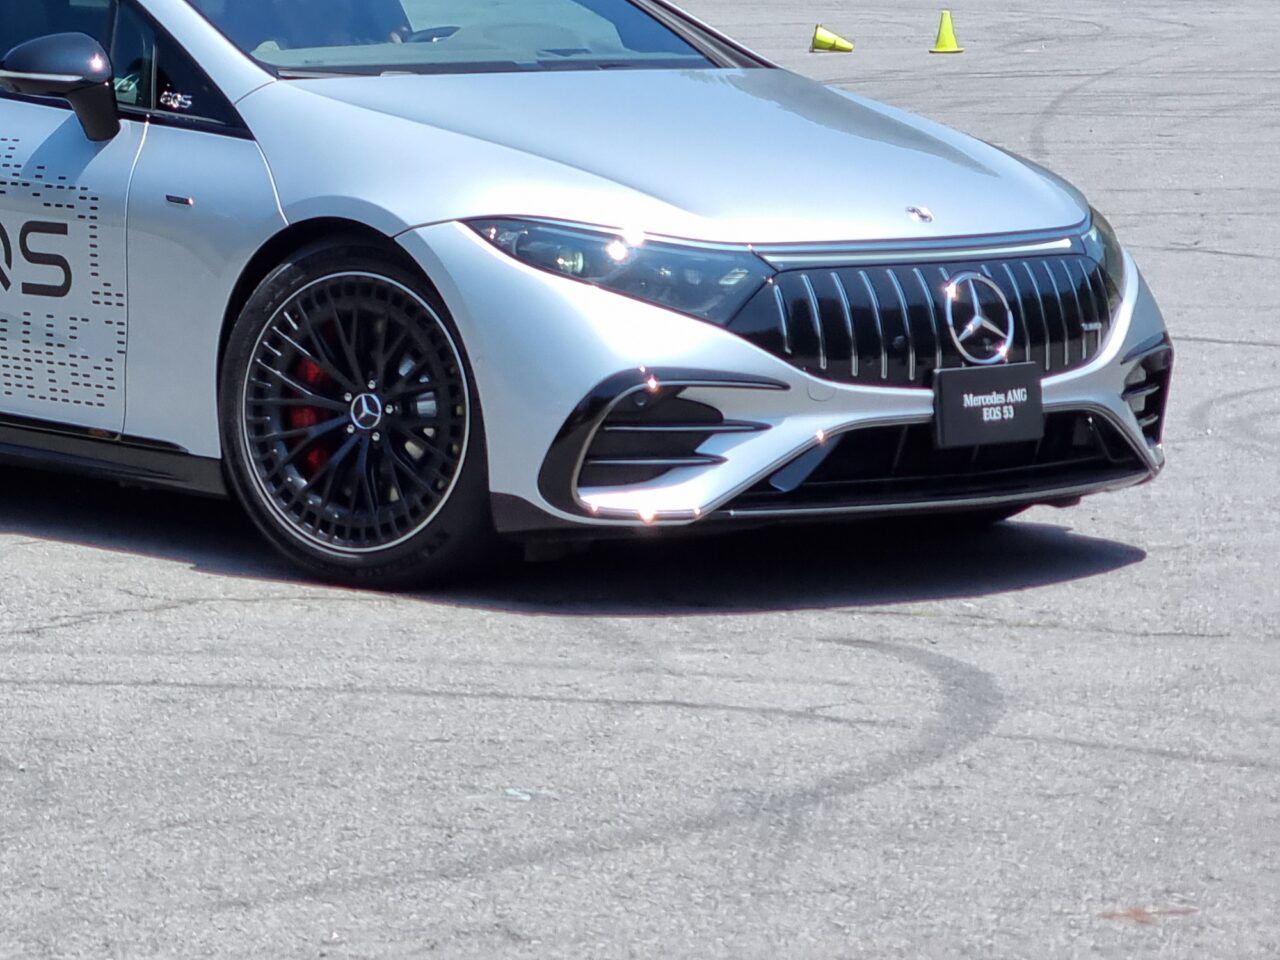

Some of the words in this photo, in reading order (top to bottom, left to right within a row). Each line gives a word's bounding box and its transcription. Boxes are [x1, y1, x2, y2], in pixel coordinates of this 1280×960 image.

[963, 391, 1006, 408] Mercedes
[1006, 387, 1028, 403] AMG
[1002, 404, 1015, 419] 53
